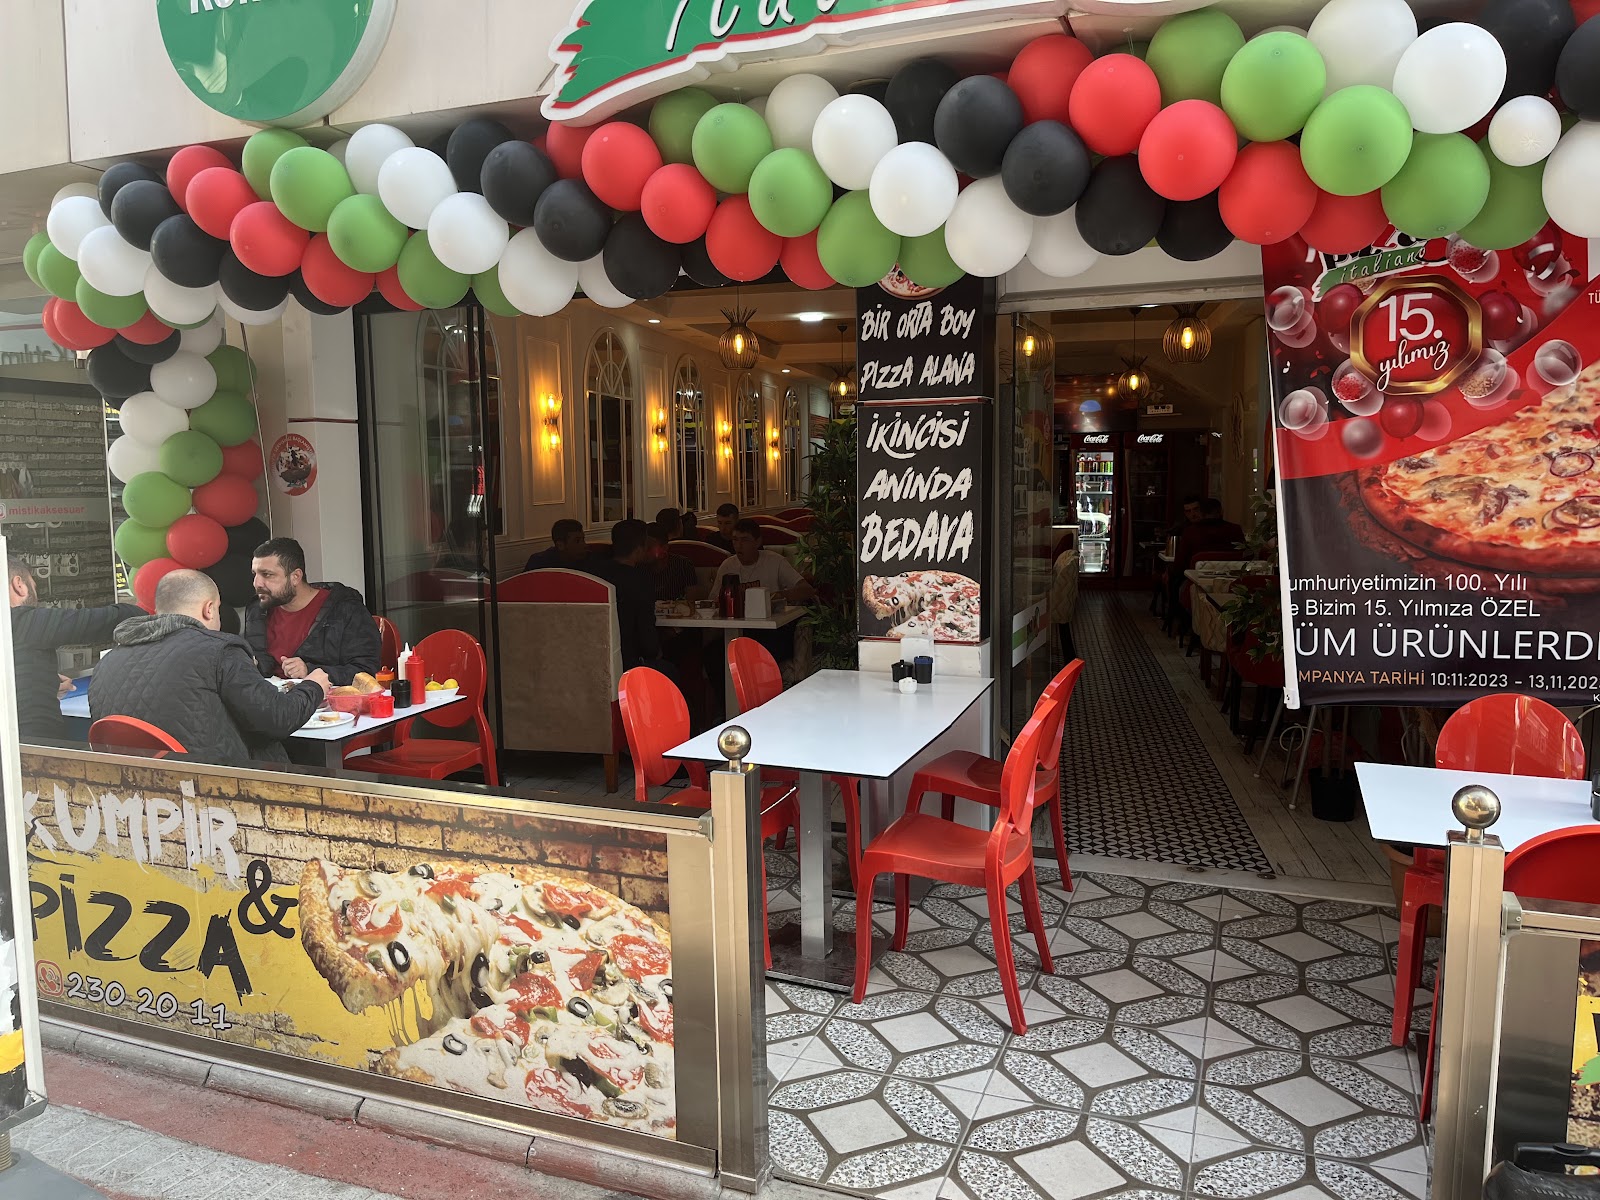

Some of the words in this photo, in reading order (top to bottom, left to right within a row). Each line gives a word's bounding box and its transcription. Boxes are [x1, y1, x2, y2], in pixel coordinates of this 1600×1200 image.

[1340, 247, 1425, 283] italiano
[897, 301, 934, 340] ORTA
[940, 303, 976, 339] BOY
[1379, 293, 1442, 342] 15.
[860, 356, 914, 393] PIZZA
[919, 351, 975, 386] ALANA
[1377, 339, 1450, 391] yılımız
[866, 411, 970, 459] İKİNCİSİ
[863, 466, 973, 502] ANINDA
[9, 506, 85, 515] mistikaksesuar
[860, 510, 974, 563] BEDAVA
[1444, 573, 1487, 591] 100.
[1494, 573, 1527, 591] Yılı
[1305, 599, 1356, 616] Bizim
[1364, 599, 1392, 616] 15.
[1399, 599, 1473, 617] Yılmıza
[1481, 596, 1541, 617] ÖZEL
[1372, 622, 1600, 661] ÜRÜNLERD
[1370, 669, 1425, 685] TARİHİ
[1430, 672, 1508, 687] 10:11:2023
[1528, 674, 1600, 691] 13,11,202
[67, 972, 126, 1007] 230
[136, 988, 179, 1020] 20
[190, 1000, 232, 1031] 11
